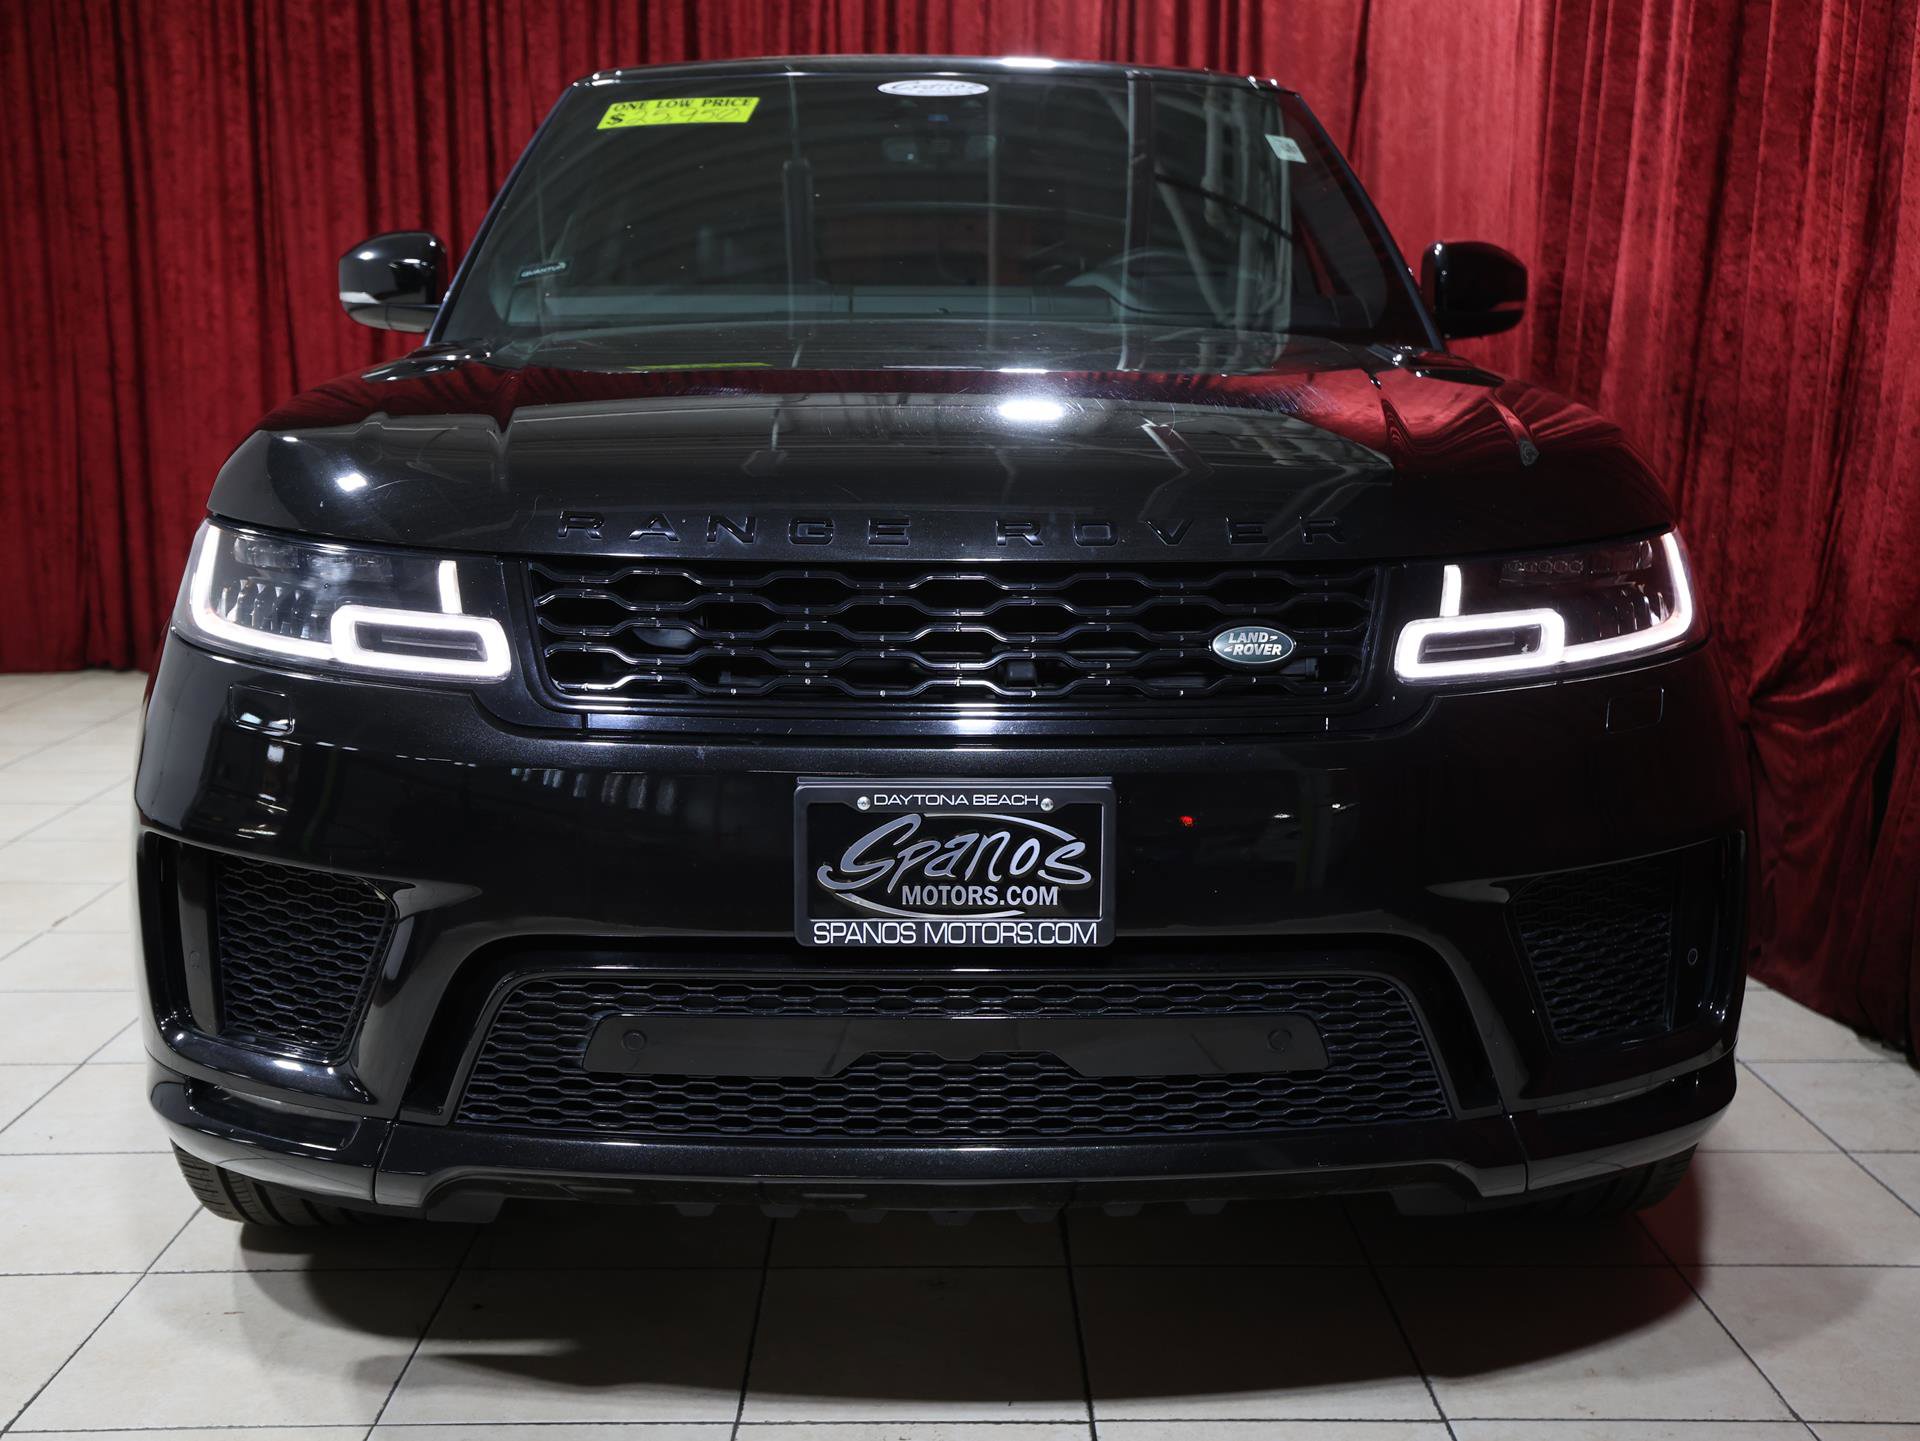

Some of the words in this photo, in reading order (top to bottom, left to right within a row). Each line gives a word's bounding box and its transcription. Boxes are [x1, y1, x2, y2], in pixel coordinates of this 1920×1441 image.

[613, 102, 647, 112] ONE
[656, 100, 691, 109] LOW
[702, 98, 751, 108] PRICE
[557, 511, 912, 546] RANGE
[995, 515, 1345, 547] ROVER
[1228, 632, 1269, 644] LAND
[1232, 643, 1282, 656] ROVER
[874, 794, 969, 806] DAYTONA
[972, 794, 1039, 806] BEACH
[816, 813, 1092, 894] Spanos
[901, 885, 1059, 906] MOTORS.COM
[813, 922, 917, 944] SPANOS
[924, 922, 1098, 944] MOTORS.COM
